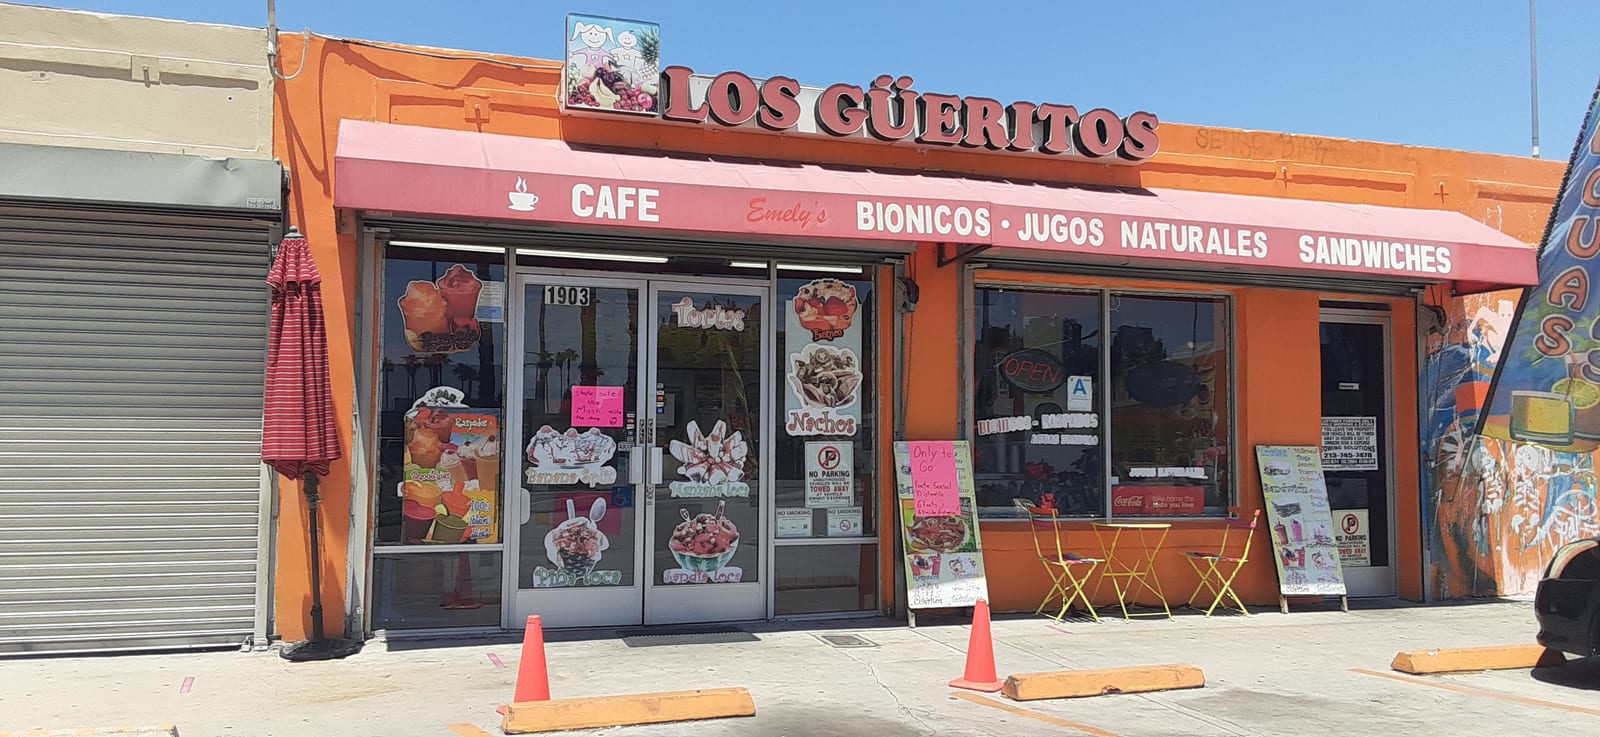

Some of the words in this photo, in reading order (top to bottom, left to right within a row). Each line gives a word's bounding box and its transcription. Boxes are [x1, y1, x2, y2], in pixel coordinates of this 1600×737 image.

[661, 65, 801, 130] LOS
[816, 75, 1161, 161] GÜERITOS
[571, 183, 660, 222] CAFE
[746, 197, 827, 227] Emely's
[857, 201, 991, 238] BIONICOS
[1018, 213, 1105, 248] JUGOS
[1120, 221, 1268, 260] NATURALES
[1298, 235, 1453, 274] SANDWICHES
[546, 287, 588, 305] 1903
[671, 298, 746, 331] Tortas
[1005, 358, 1063, 384] OPEN
[1073, 378, 1086, 395] A
[788, 411, 857, 433] Nachos
[914, 445, 937, 462] Only
[942, 447, 952, 458] to
[822, 470, 850, 478] PARKING
[919, 460, 934, 472] Go
[526, 469, 578, 484] Banana
